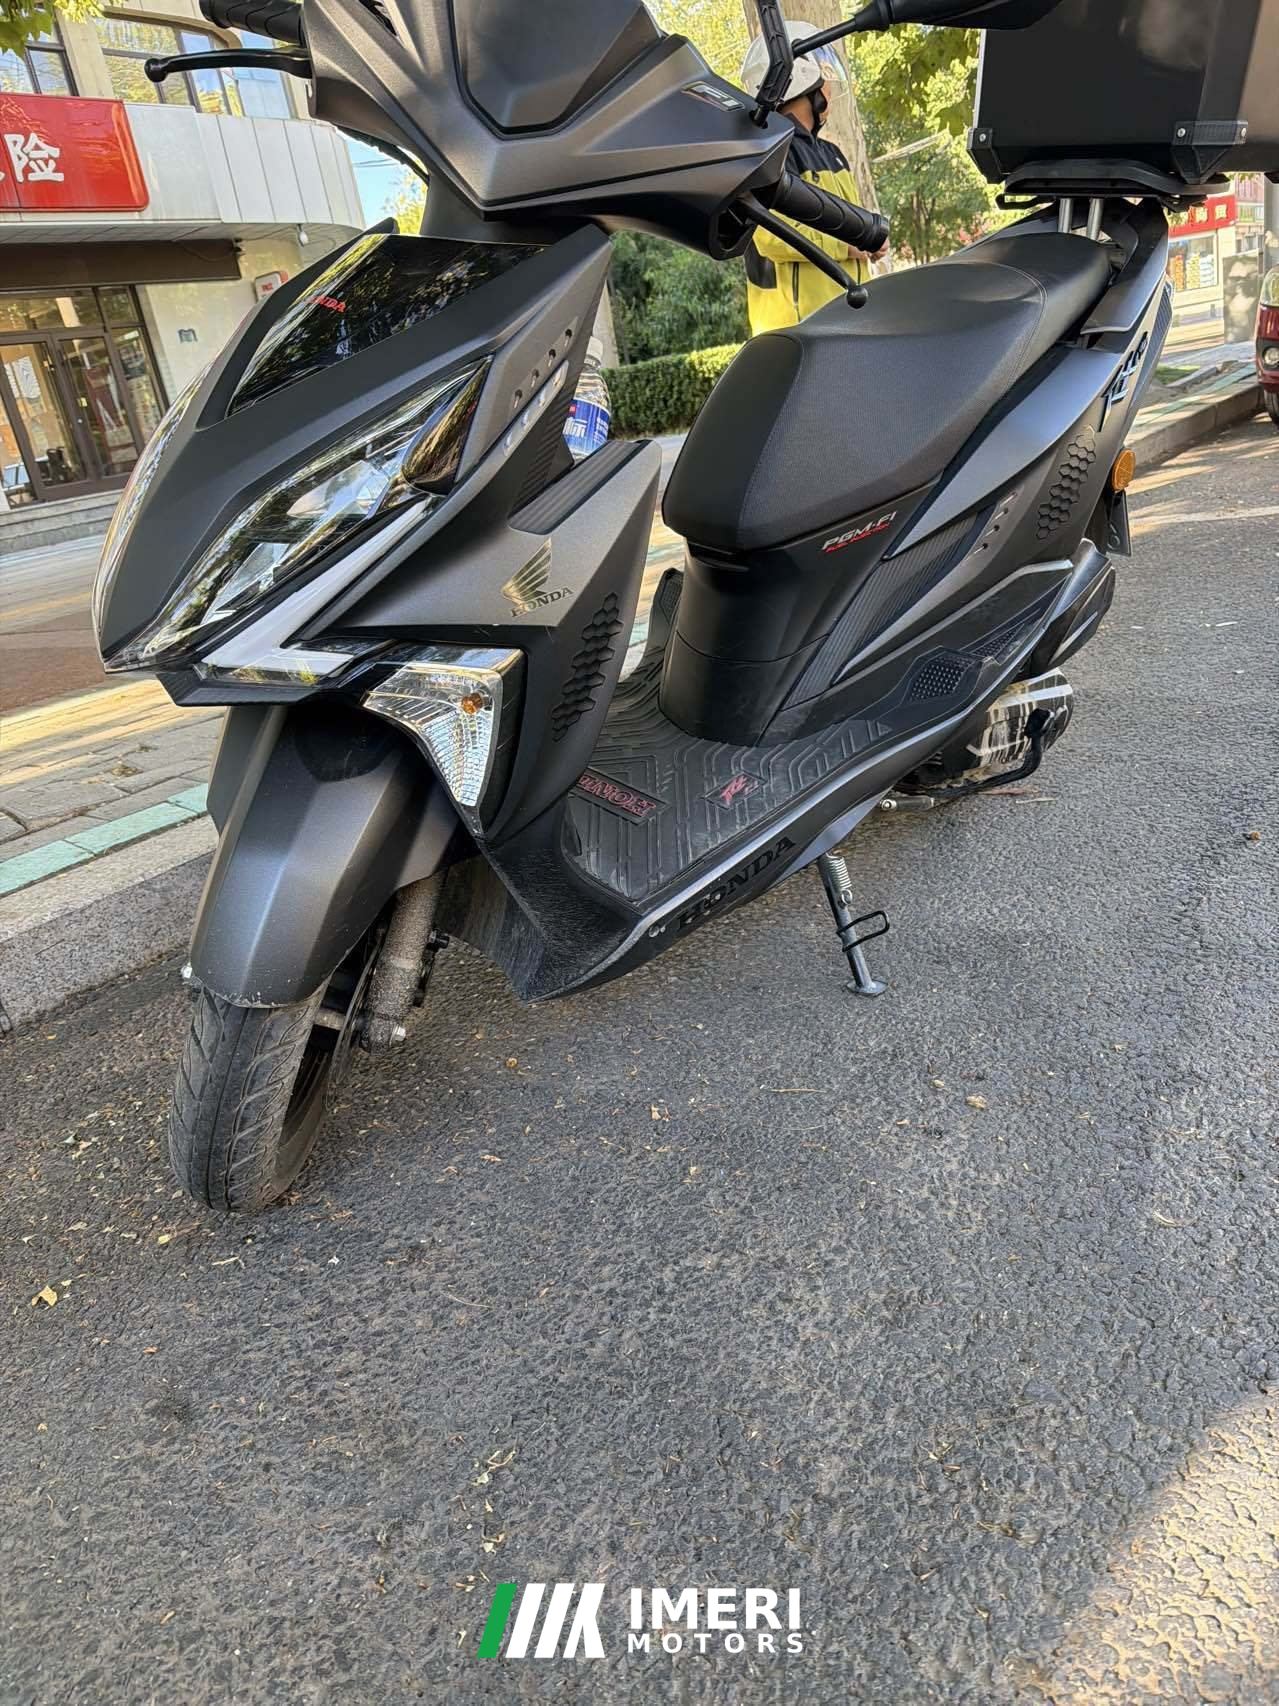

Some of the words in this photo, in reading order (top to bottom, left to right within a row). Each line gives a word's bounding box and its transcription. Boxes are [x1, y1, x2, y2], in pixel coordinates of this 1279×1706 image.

[0, 132, 64, 182] 险
[511, 587, 574, 618] HONDA
[678, 836, 796, 932] HONDA
